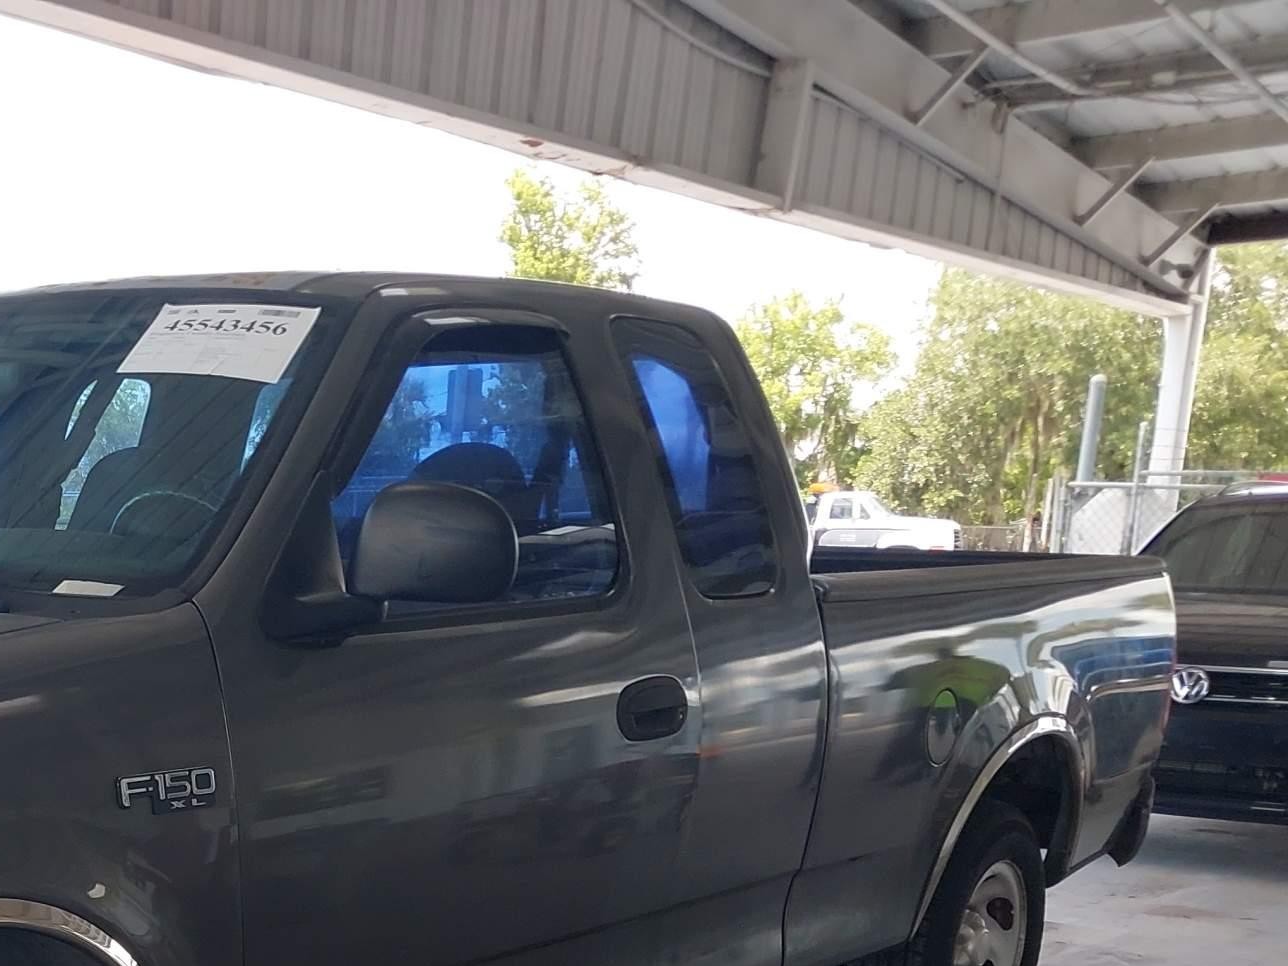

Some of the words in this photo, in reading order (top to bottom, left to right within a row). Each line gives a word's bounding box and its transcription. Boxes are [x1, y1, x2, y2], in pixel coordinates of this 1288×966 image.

[164, 318, 289, 336] 45543456
[119, 767, 216, 807] F-150
[169, 797, 207, 810] XL
